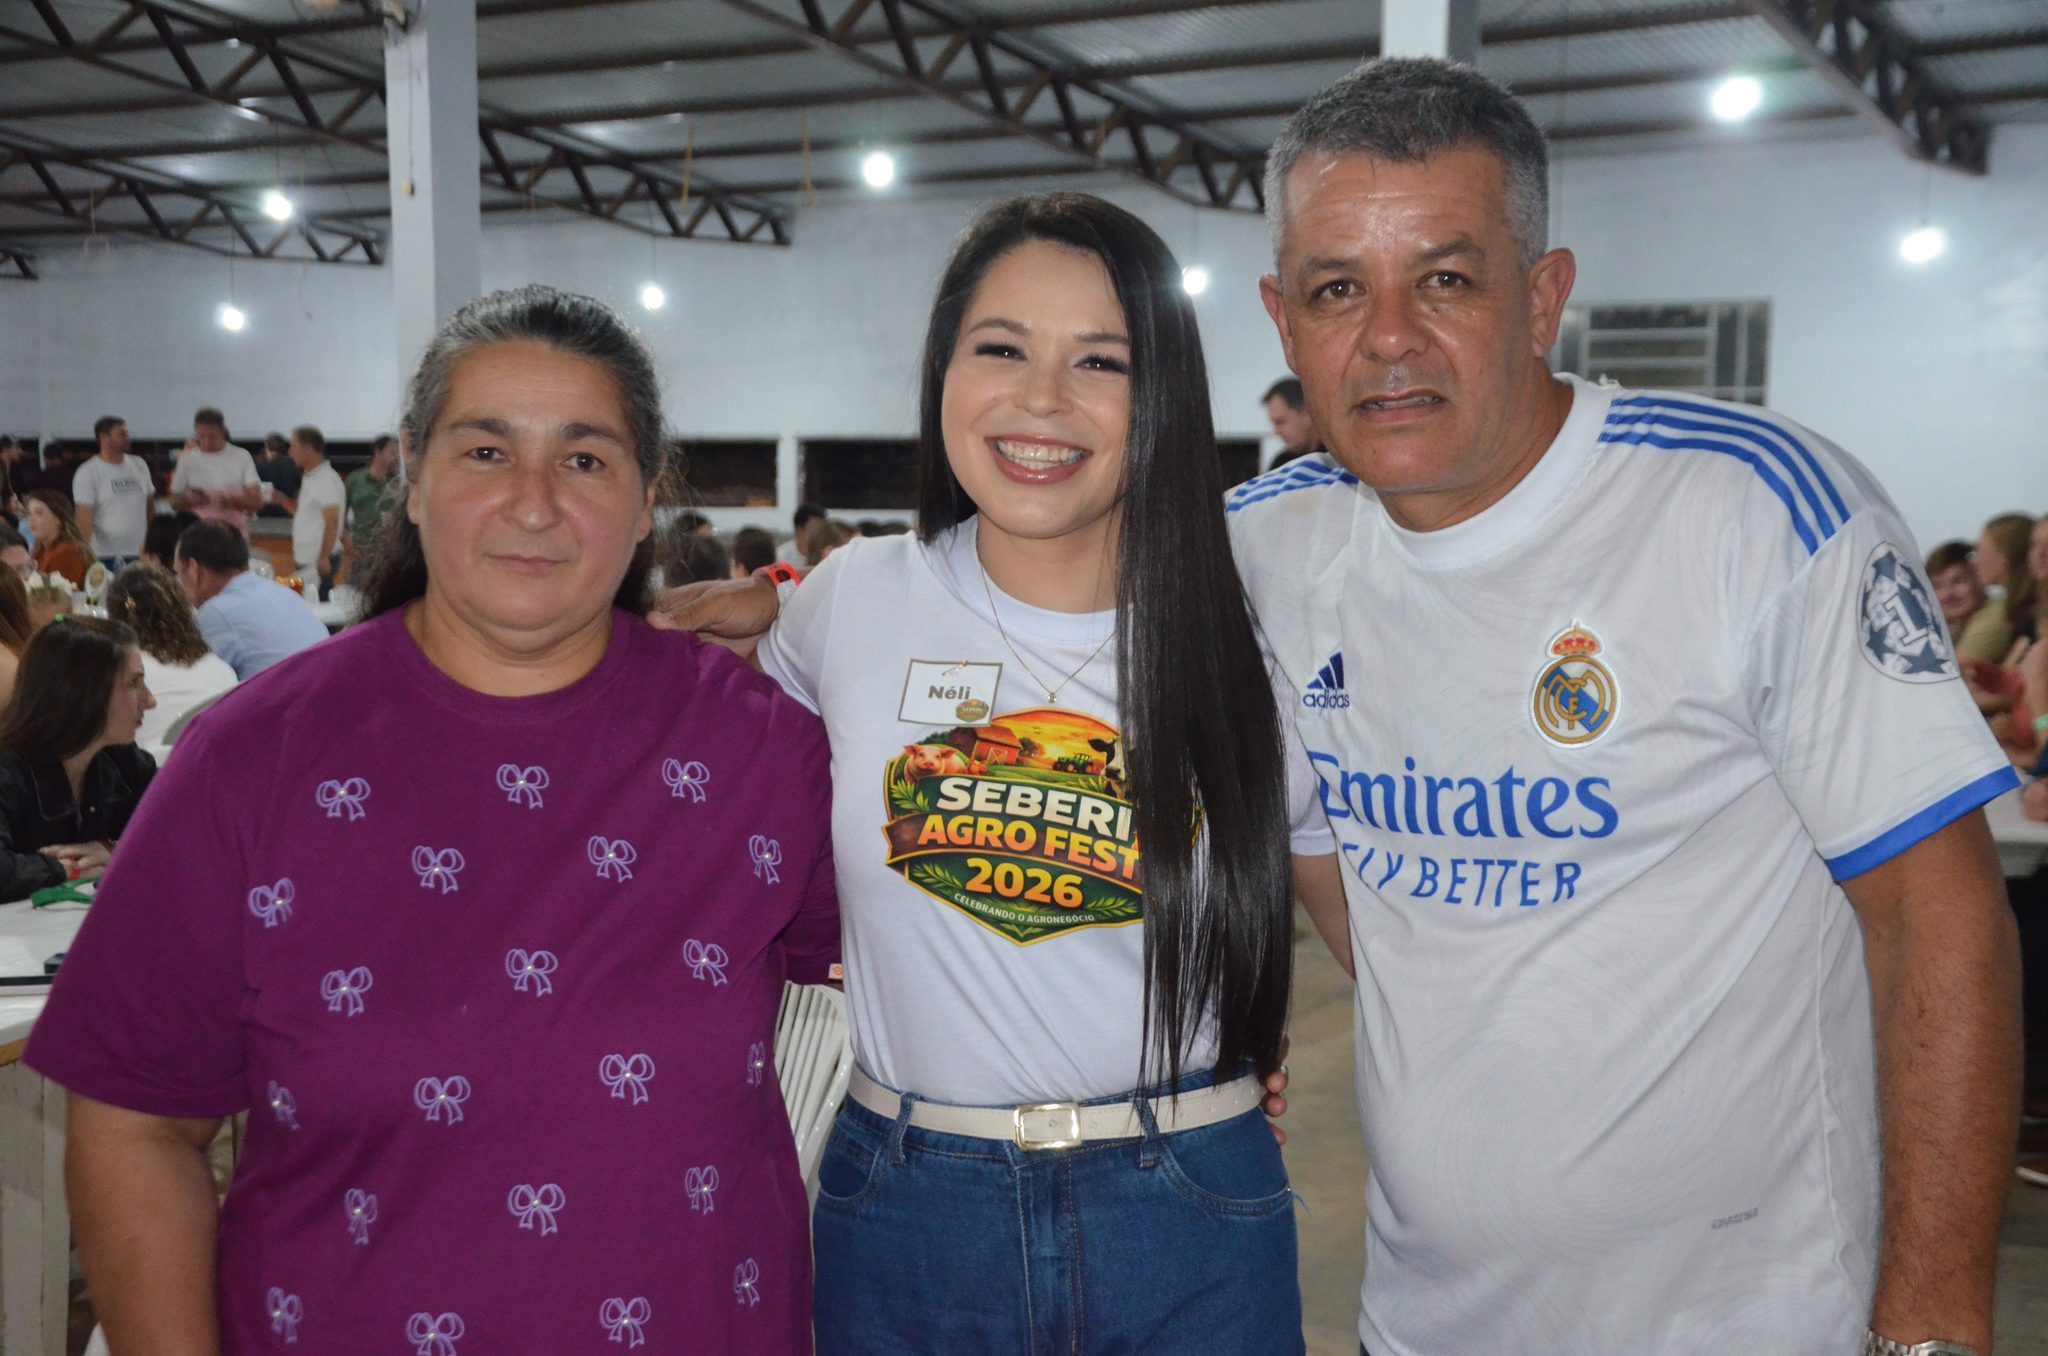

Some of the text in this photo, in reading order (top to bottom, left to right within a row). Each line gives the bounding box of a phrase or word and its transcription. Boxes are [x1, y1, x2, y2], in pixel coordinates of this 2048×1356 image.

[928, 685, 971, 700] Néli
[1302, 687, 1350, 709] adidas
[936, 777, 1132, 842] SEBERI
[917, 814, 1141, 880] AGRO FEST
[965, 857, 1083, 909] 2026
[1342, 843, 1582, 908] LY BETTER
[954, 892, 1095, 924] CELEBRANDO O AGRONEGÓCIO
